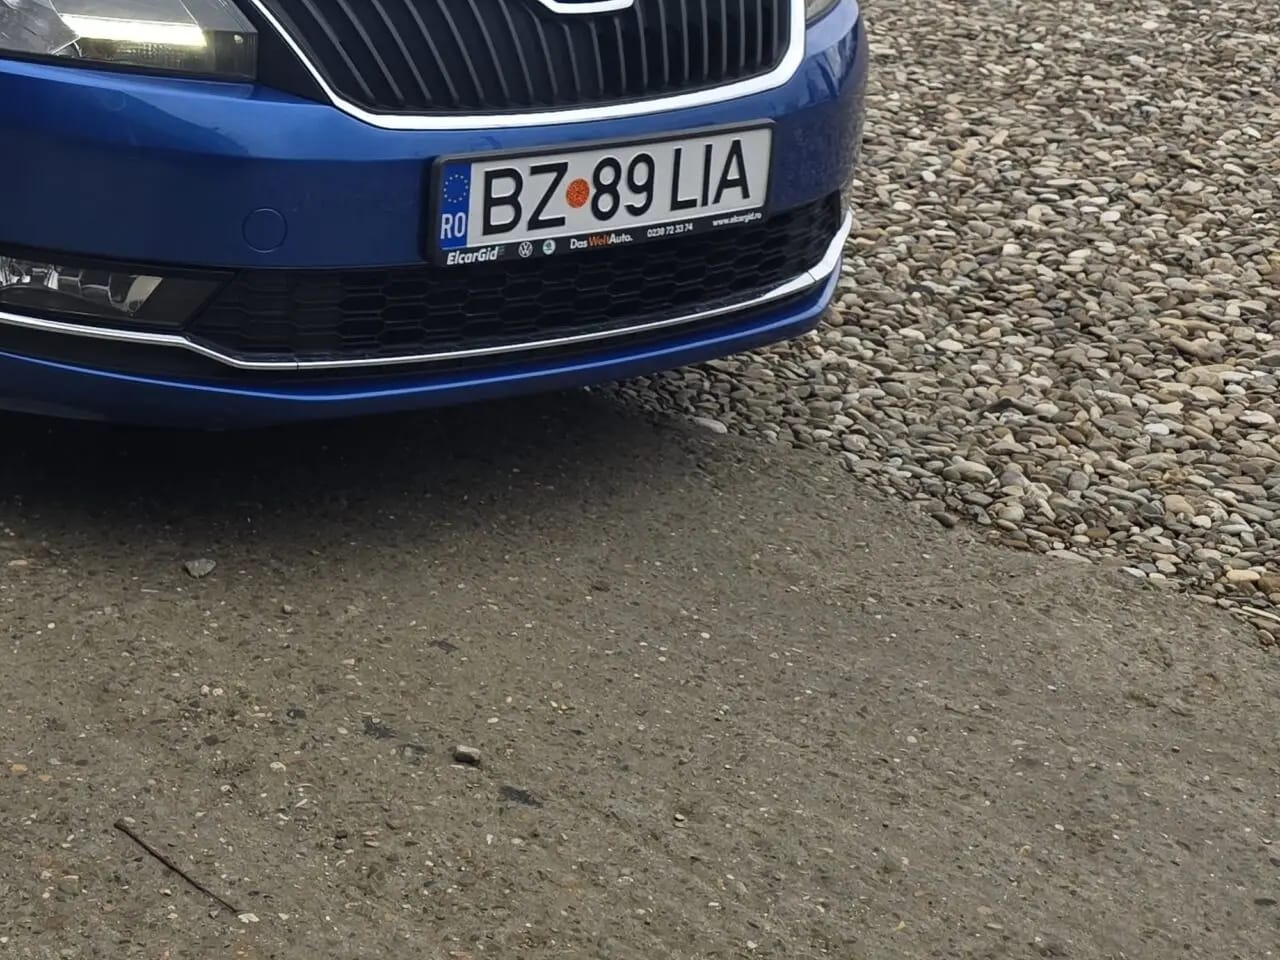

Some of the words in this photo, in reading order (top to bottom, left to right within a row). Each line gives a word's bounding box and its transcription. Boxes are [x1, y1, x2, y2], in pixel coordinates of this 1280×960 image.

[482, 161, 569, 236] BZ
[590, 153, 656, 222] 89
[669, 139, 751, 212] LIA
[440, 212, 467, 241] RO
[447, 245, 499, 265] ElcarGid
